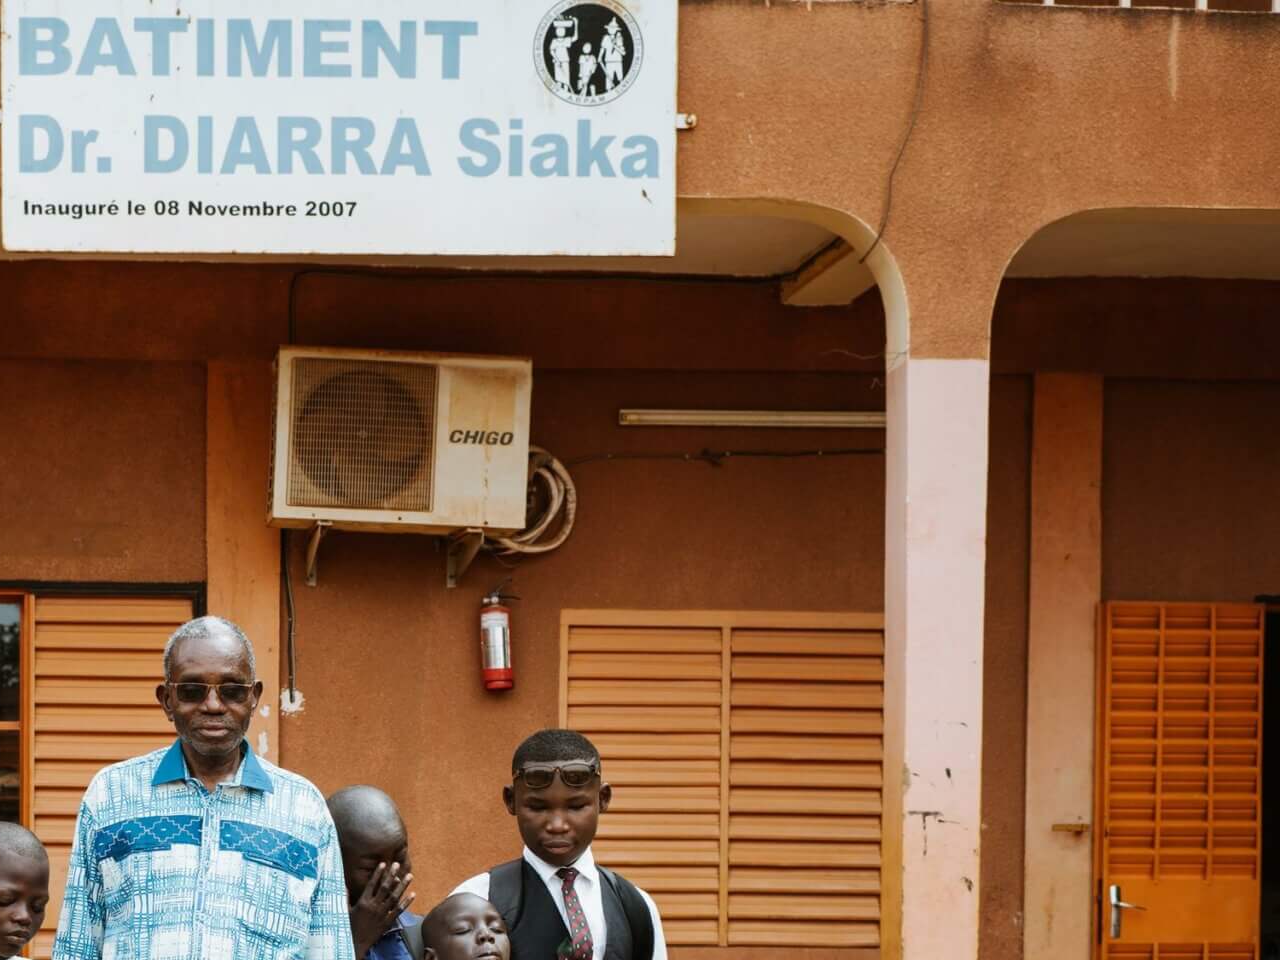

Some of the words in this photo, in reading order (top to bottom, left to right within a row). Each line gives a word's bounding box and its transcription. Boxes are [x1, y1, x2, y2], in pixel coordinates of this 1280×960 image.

[18, 16, 478, 80] BATIMENT
[18, 114, 112, 174] Dr.
[143, 114, 432, 177] DIARRA
[457, 117, 660, 178] Siaka
[23, 199, 119, 220] Inauguré
[127, 200, 146, 216] le
[154, 200, 180, 216] 08
[188, 200, 297, 217] Novembre
[305, 201, 357, 217] 2007
[449, 429, 514, 446] CHIGO
